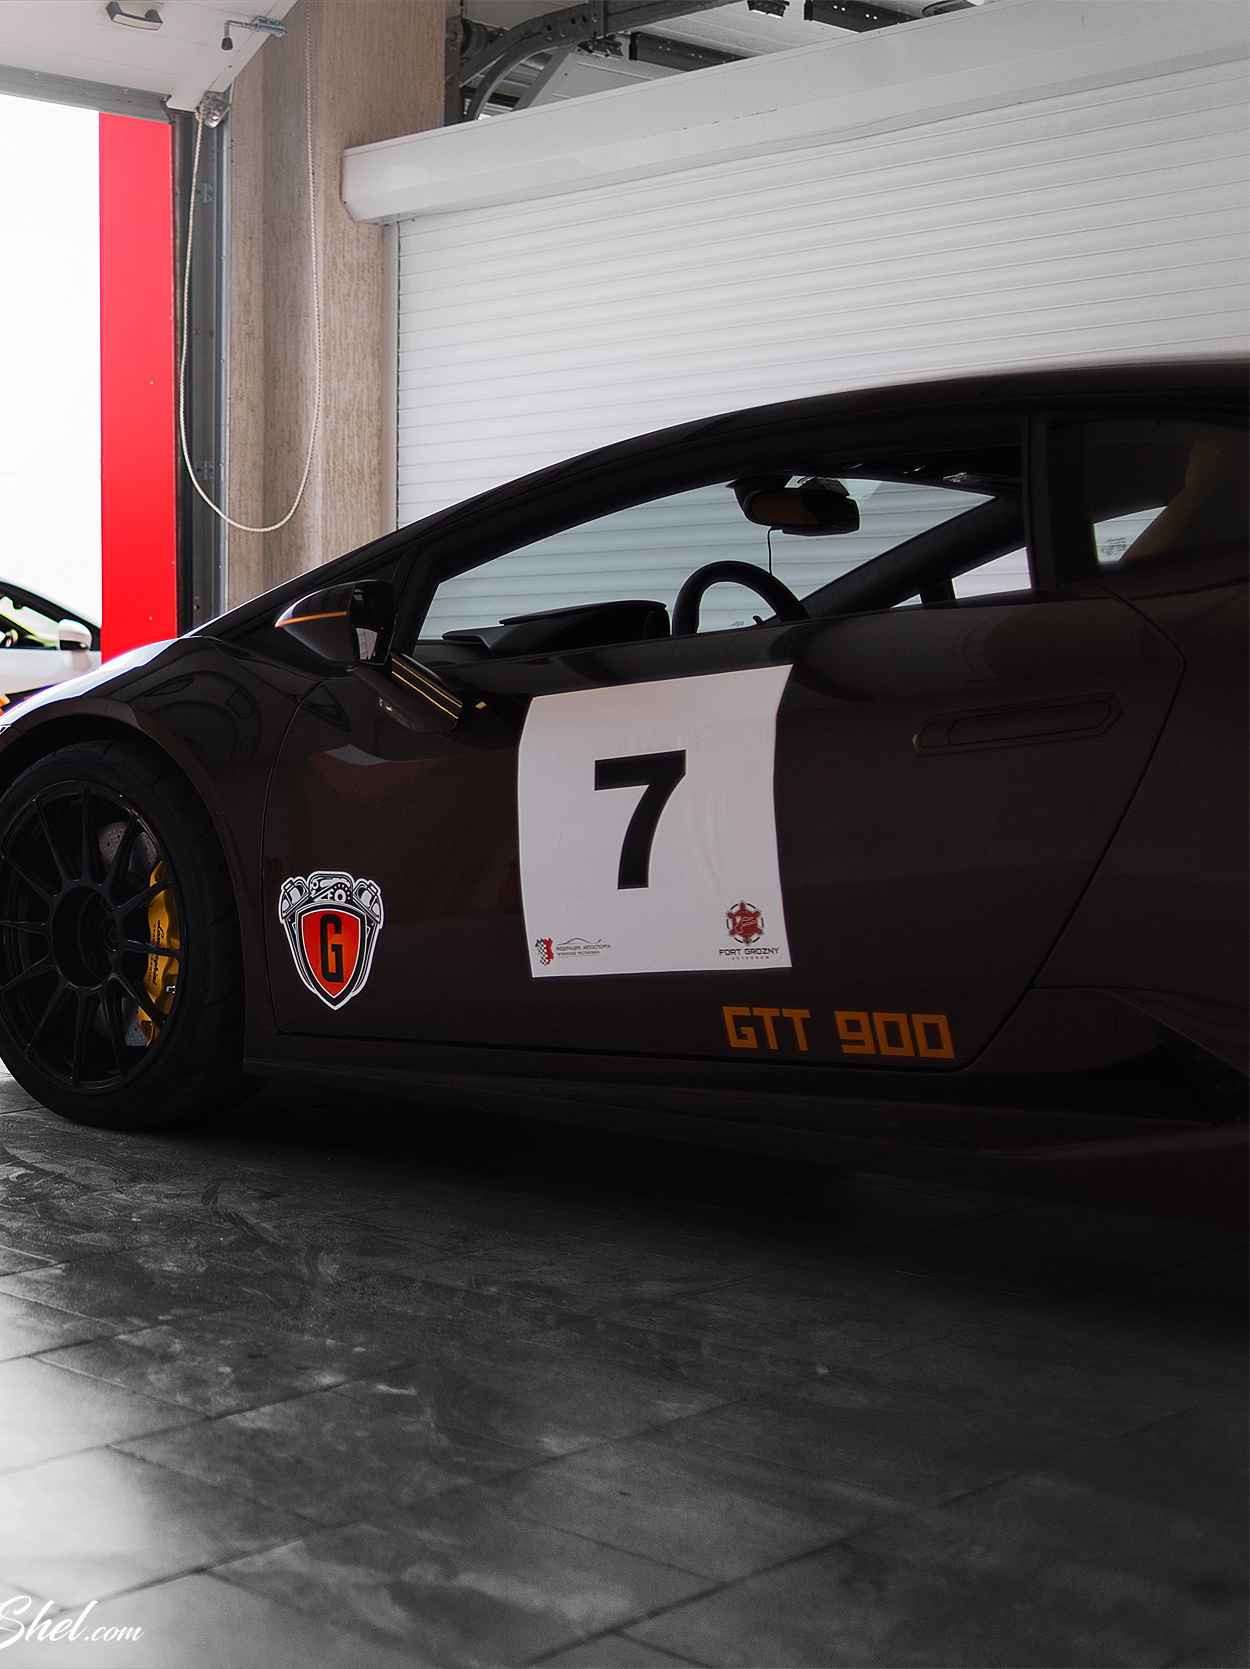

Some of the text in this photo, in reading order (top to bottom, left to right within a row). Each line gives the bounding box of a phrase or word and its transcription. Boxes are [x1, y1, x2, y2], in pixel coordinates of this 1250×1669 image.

[594, 749, 686, 889] 7
[320, 914, 344, 983] G
[719, 947, 780, 956] FORT GROZNY
[722, 1006, 955, 1059] GTT 900
